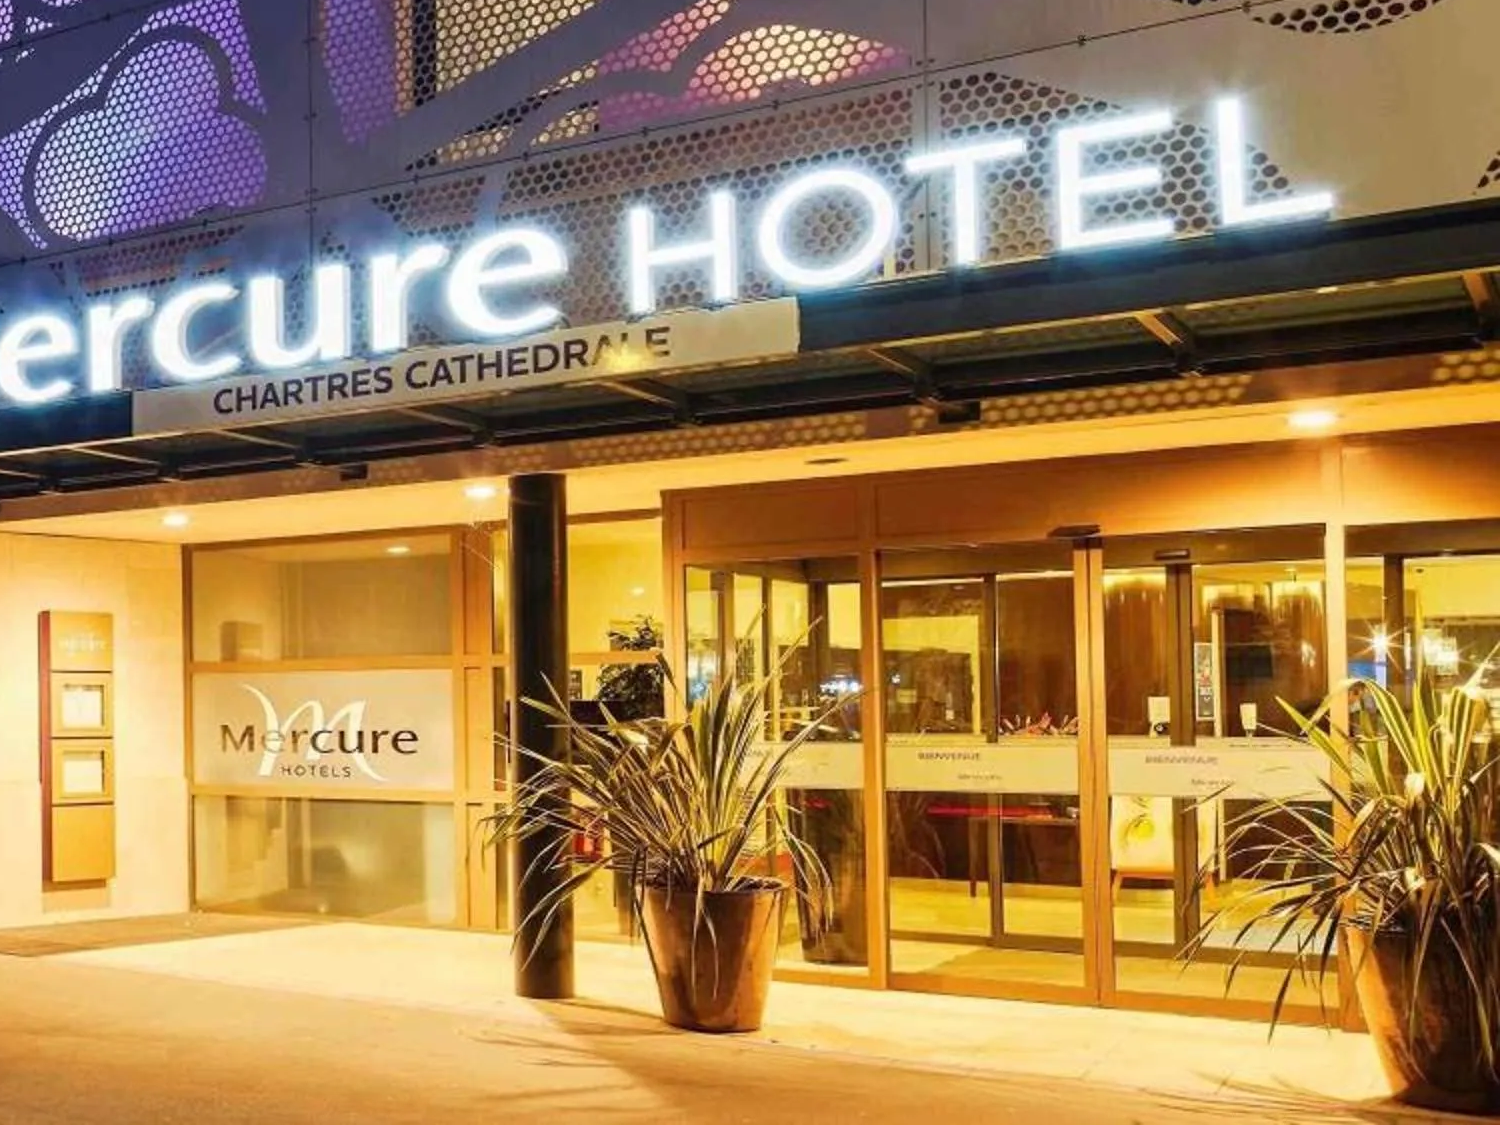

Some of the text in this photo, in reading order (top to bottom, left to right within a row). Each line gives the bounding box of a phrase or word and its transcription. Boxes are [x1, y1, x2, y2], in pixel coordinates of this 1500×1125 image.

[629, 97, 1335, 314] HOTEL
[213, 358, 393, 415] CHARTRES
[219, 723, 419, 755] Mercure
[280, 765, 351, 778] HOTELS
